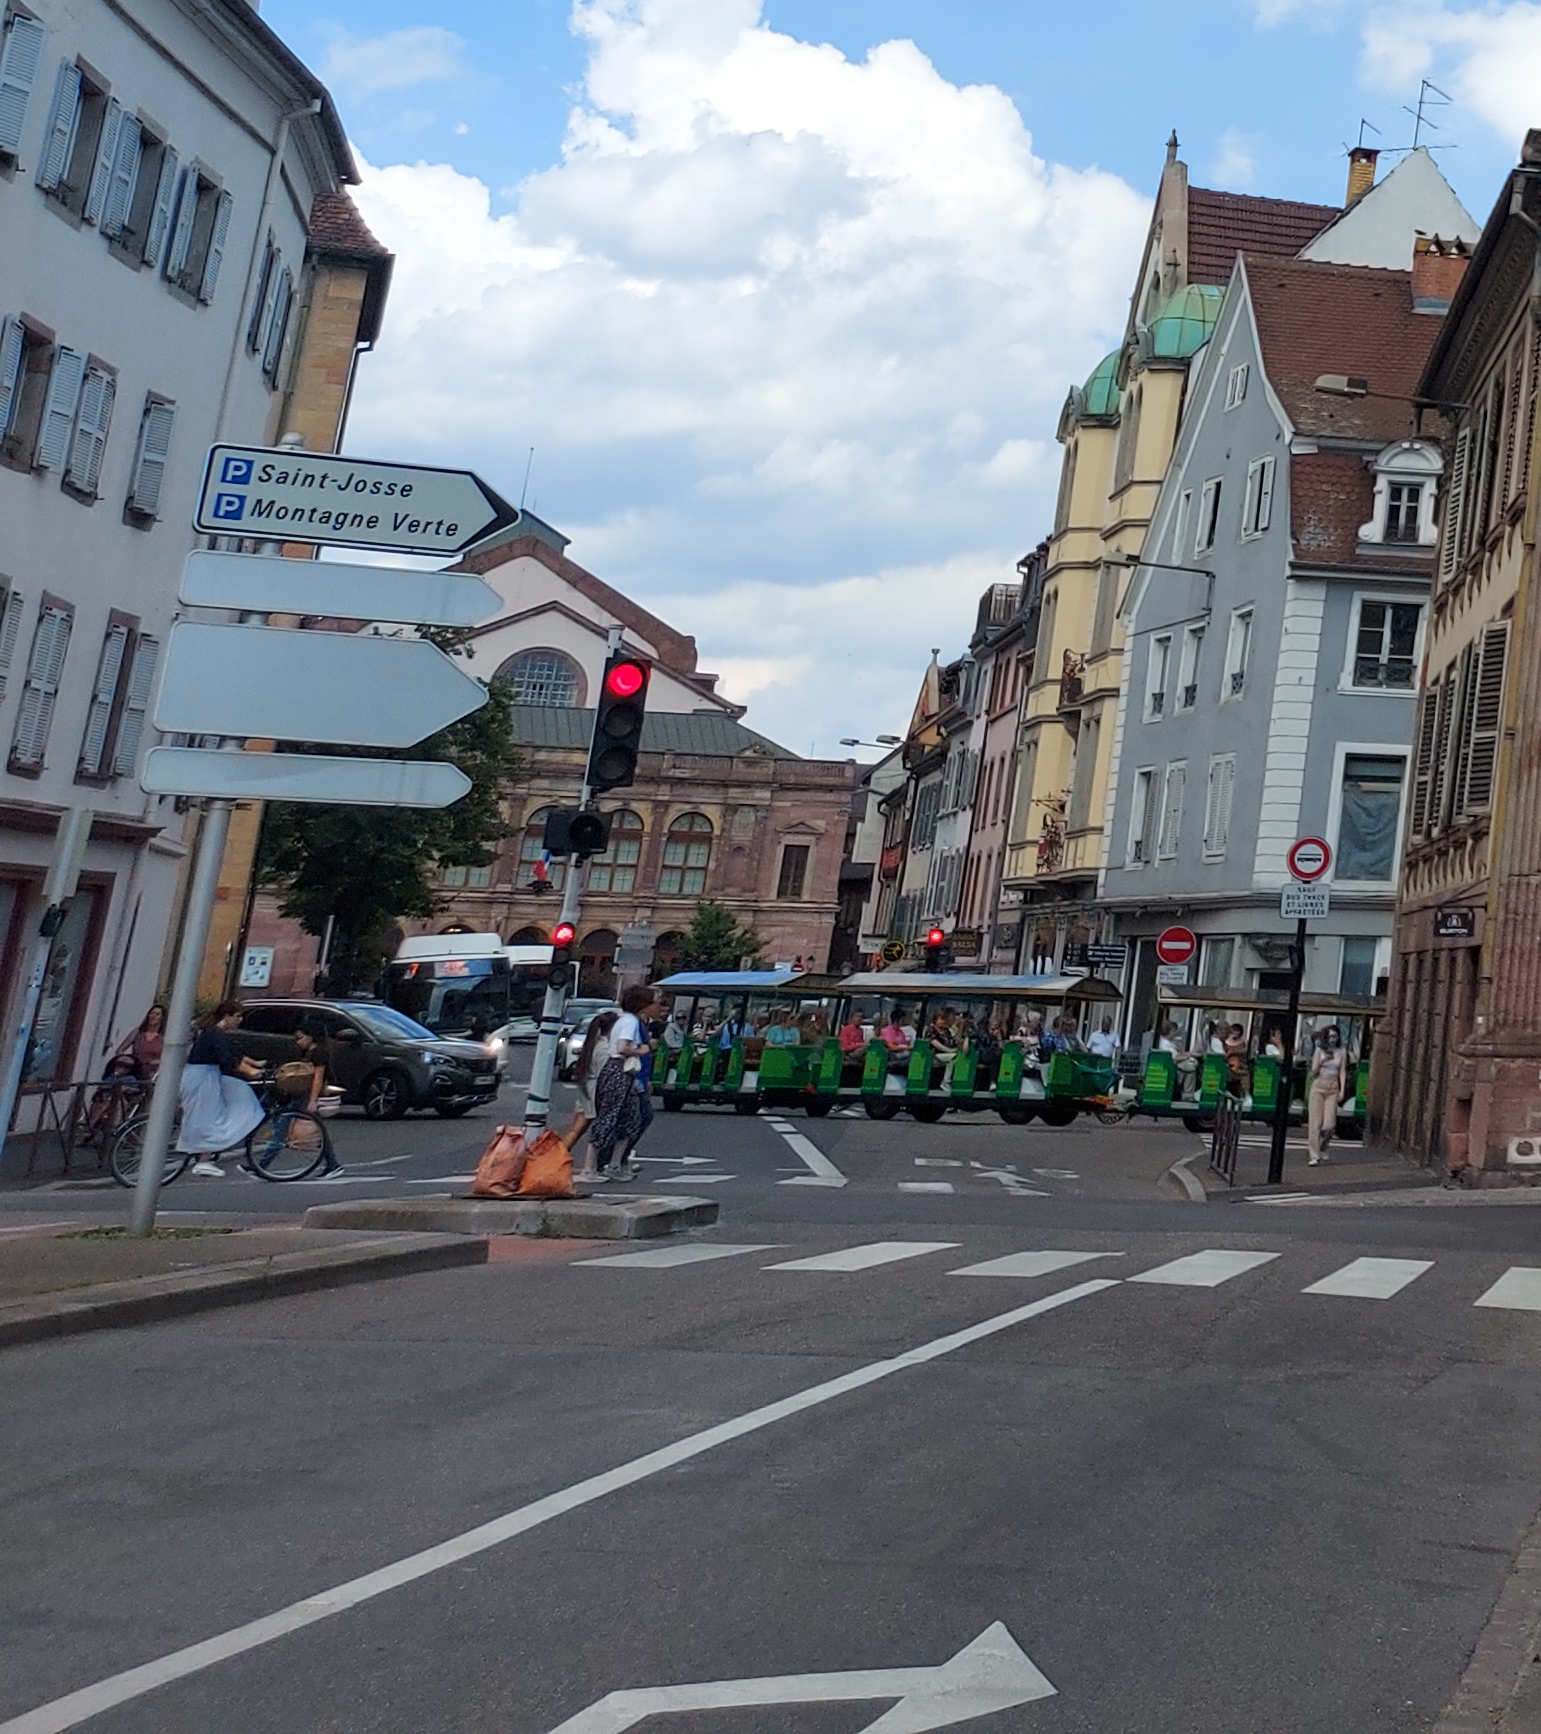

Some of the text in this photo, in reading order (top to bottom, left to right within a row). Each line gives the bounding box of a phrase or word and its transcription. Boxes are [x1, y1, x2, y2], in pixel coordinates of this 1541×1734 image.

[257, 464, 414, 498] Saint-Josse
[250, 498, 380, 531] Montagne
[392, 512, 460, 537] Verte
